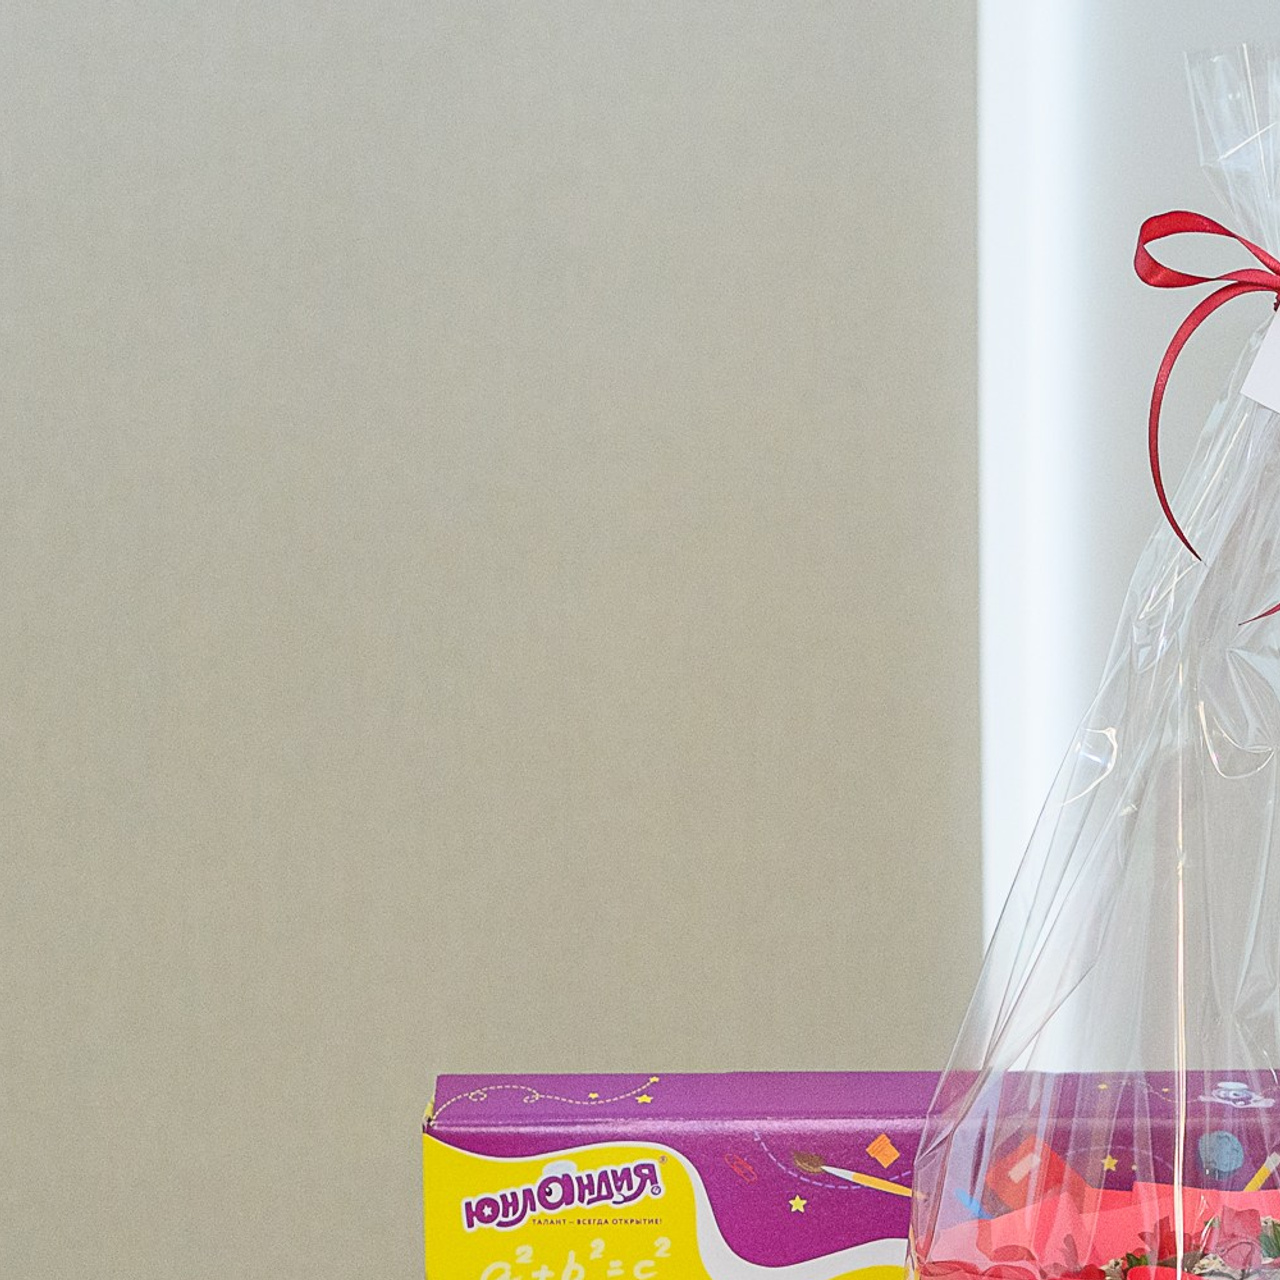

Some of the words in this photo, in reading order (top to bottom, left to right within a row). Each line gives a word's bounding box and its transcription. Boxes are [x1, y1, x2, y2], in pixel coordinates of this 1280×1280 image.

[532, 1218, 567, 1226] ТАЛАНТ
[576, 1217, 609, 1227] ВСЕГДА
[611, 1217, 663, 1226] ОТКРЫТИЕ!
